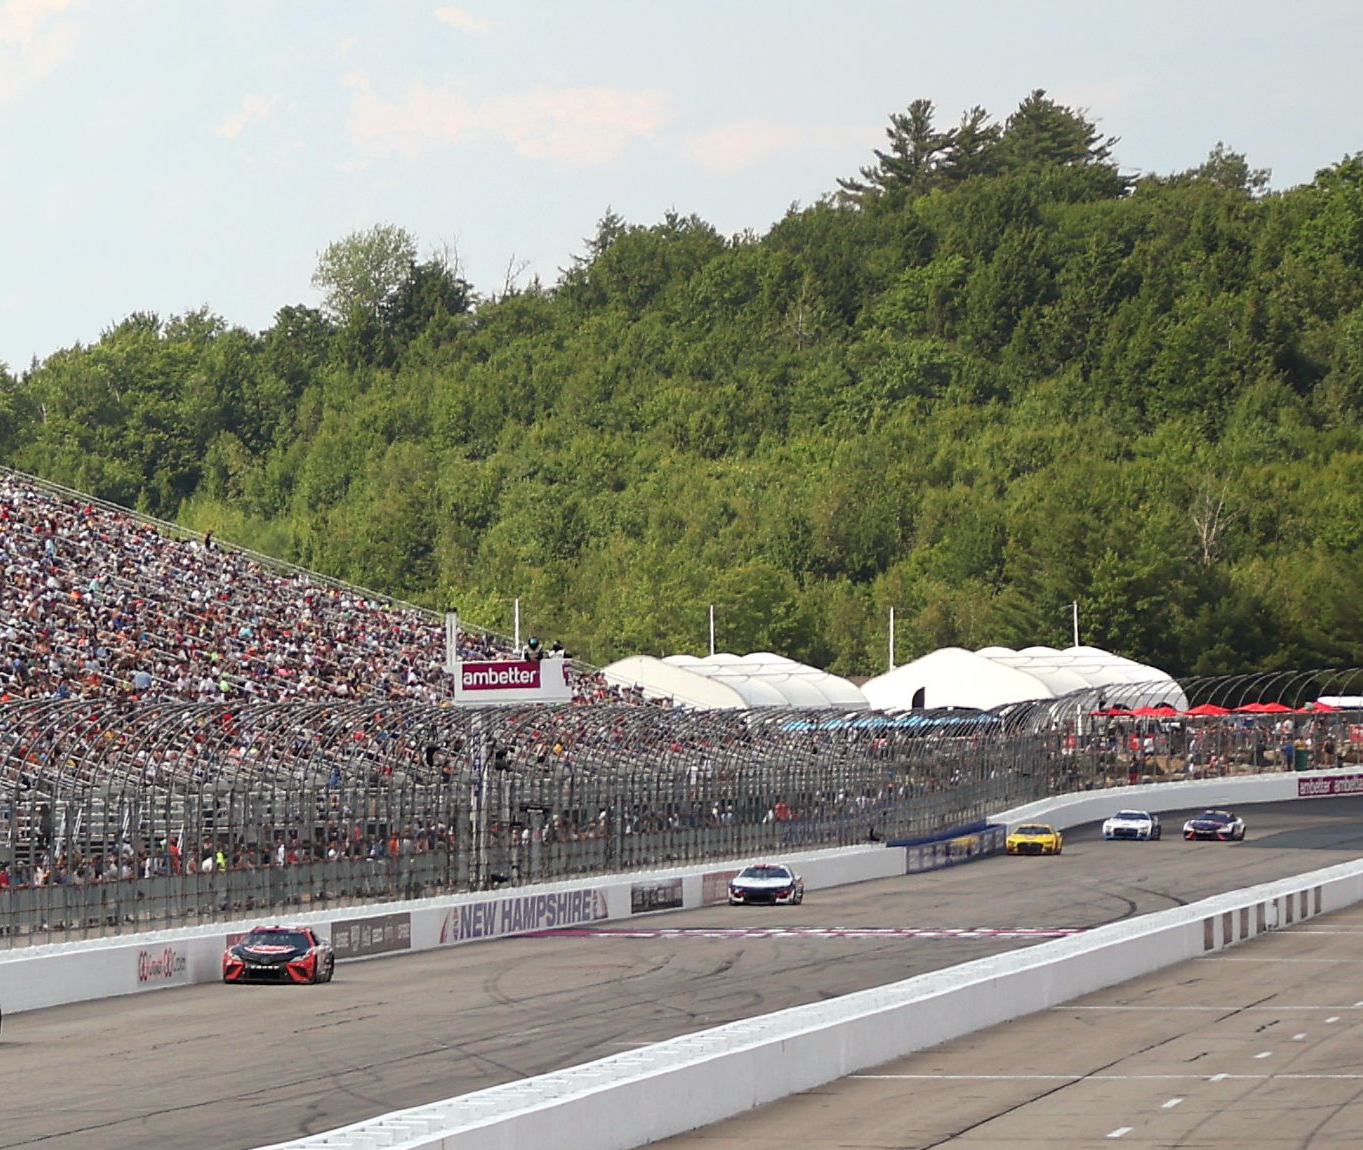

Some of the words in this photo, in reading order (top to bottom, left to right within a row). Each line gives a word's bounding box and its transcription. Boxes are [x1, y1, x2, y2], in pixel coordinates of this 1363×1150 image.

[463, 667, 536, 686] ambetter
[460, 903, 497, 939] NEW
[501, 888, 592, 932] HAMPSHIRE
